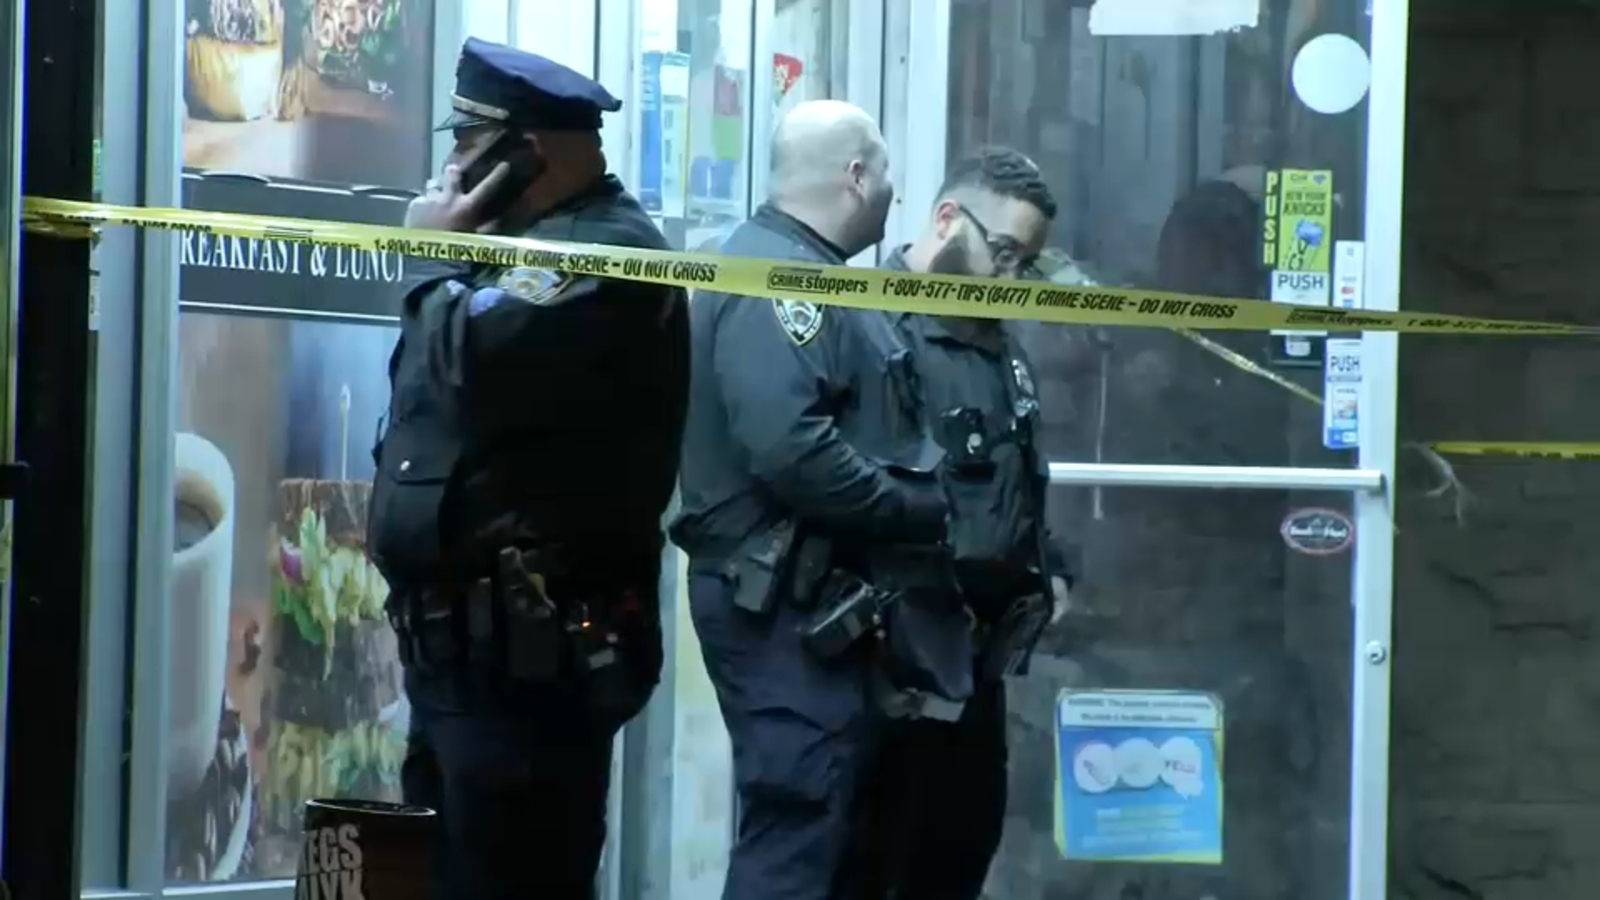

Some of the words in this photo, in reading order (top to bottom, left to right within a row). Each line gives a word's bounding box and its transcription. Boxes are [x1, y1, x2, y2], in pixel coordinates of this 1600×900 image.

[1263, 171, 1279, 264] PUSH
[310, 244, 327, 277] &
[523, 250, 566, 270] CRIME
[567, 252, 611, 274] SCENE
[623, 257, 641, 275] DO
[644, 259, 670, 279] NOT
[672, 260, 718, 283] CROSS
[1278, 273, 1325, 291] PUSH
[986, 284, 1031, 307] (8477)
[1035, 289, 1081, 308] CRIME
[1081, 292, 1128, 312] SCENE
[1138, 298, 1159, 314] DO
[1160, 299, 1191, 316] NOT
[1190, 301, 1238, 319] CROSS
[1330, 354, 1360, 373] PUSH
